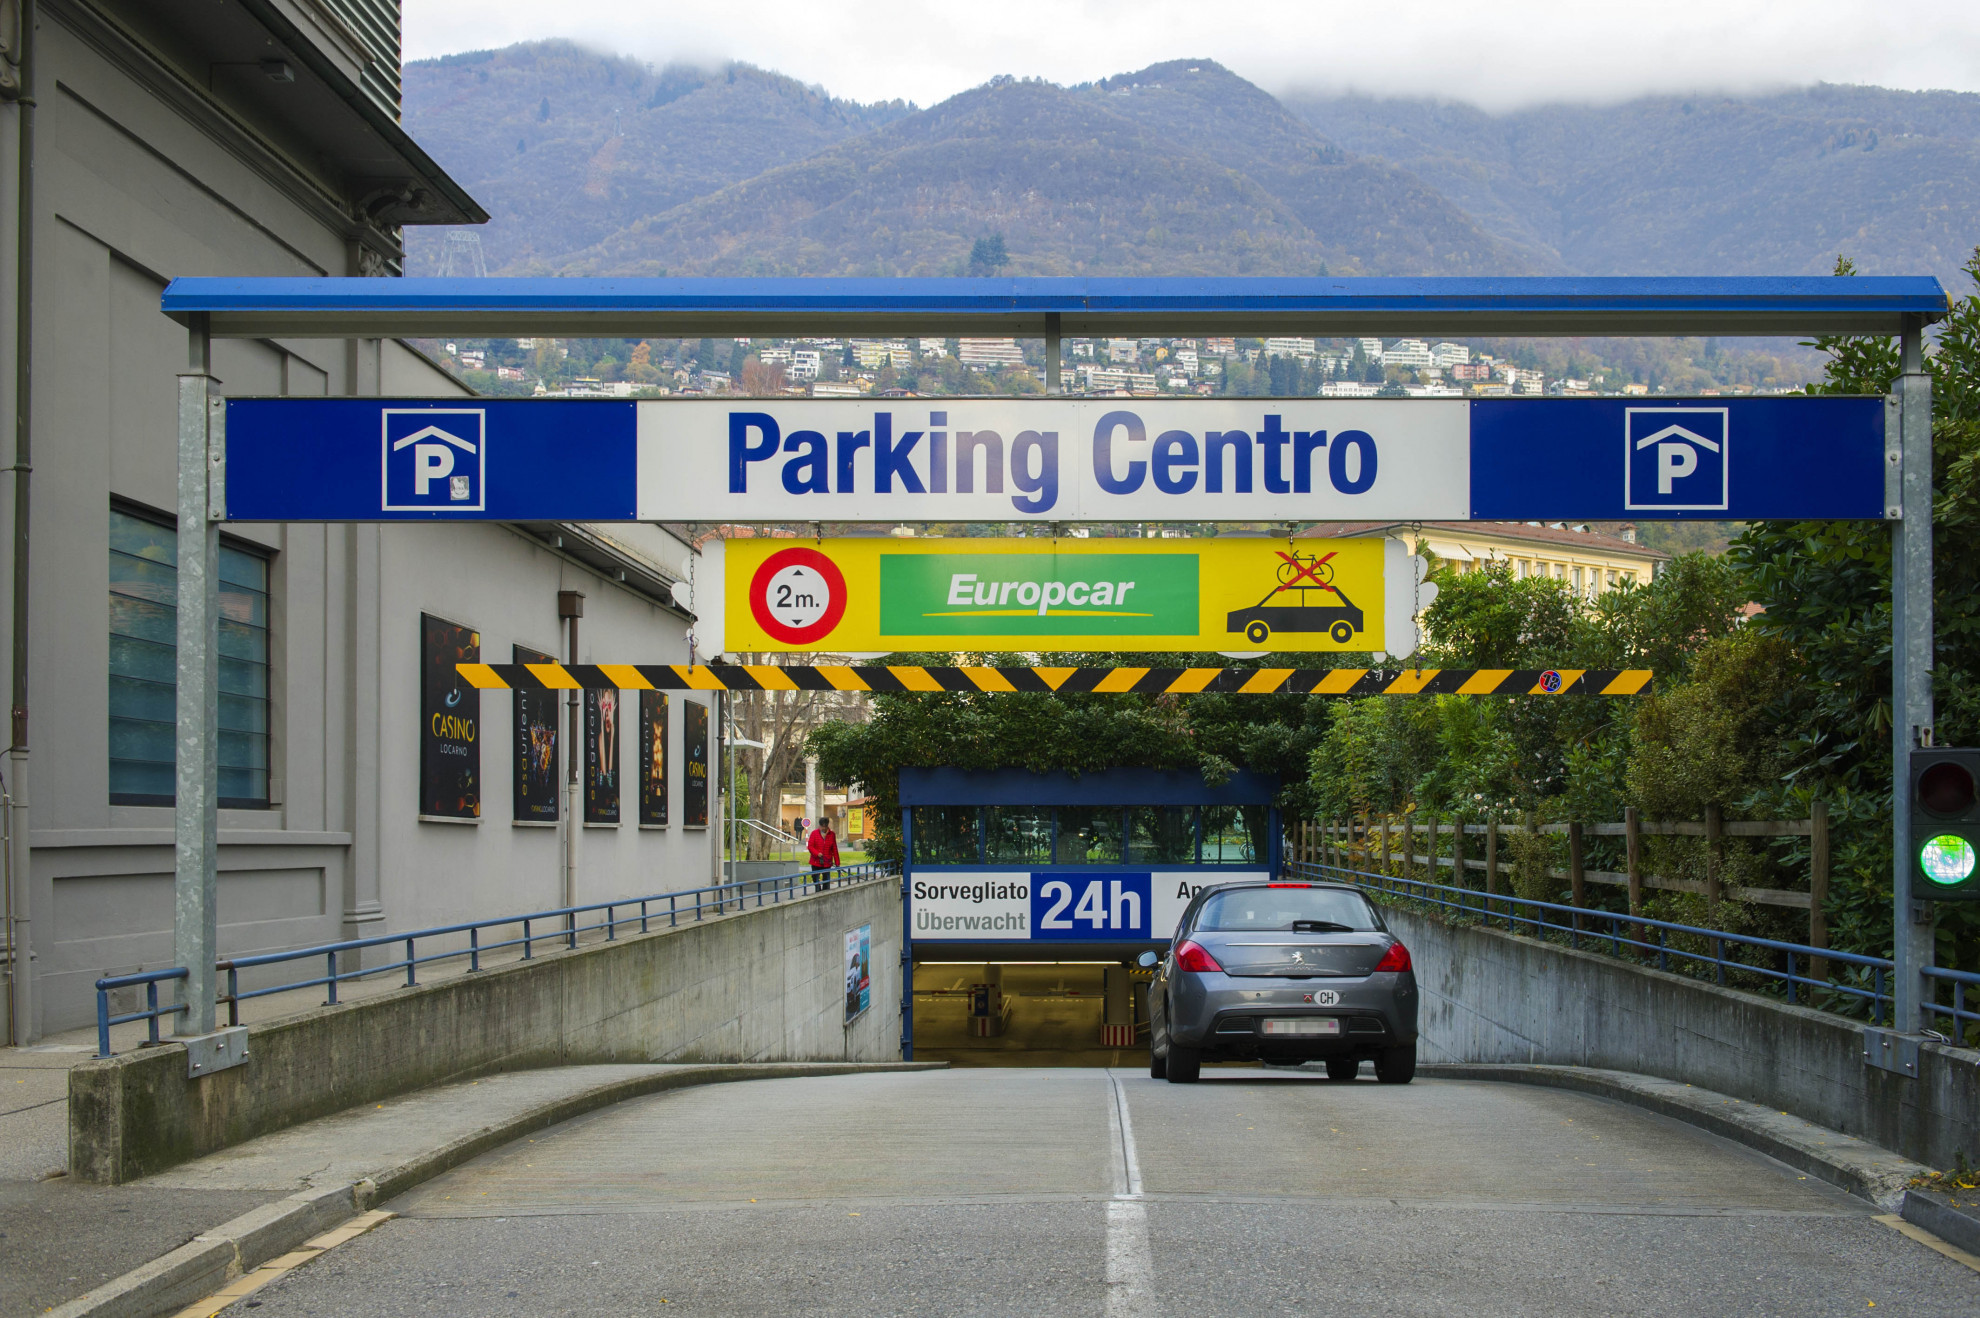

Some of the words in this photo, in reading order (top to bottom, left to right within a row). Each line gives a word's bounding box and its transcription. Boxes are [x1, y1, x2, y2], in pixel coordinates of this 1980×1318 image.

[415, 444, 455, 495] P
[728, 411, 1059, 514] Parking
[1092, 410, 1378, 495] Centro
[1658, 443, 1698, 494] P
[947, 573, 1136, 617] Europcar
[432, 712, 476, 742] CASINO
[520, 688, 528, 796] esaurient
[440, 743, 468, 757] LOCARNO
[914, 881, 1029, 904] Sorvegliato
[1040, 880, 1141, 930] 24h
[916, 908, 1026, 930] Überwacht
[1320, 991, 1334, 1005] CH
